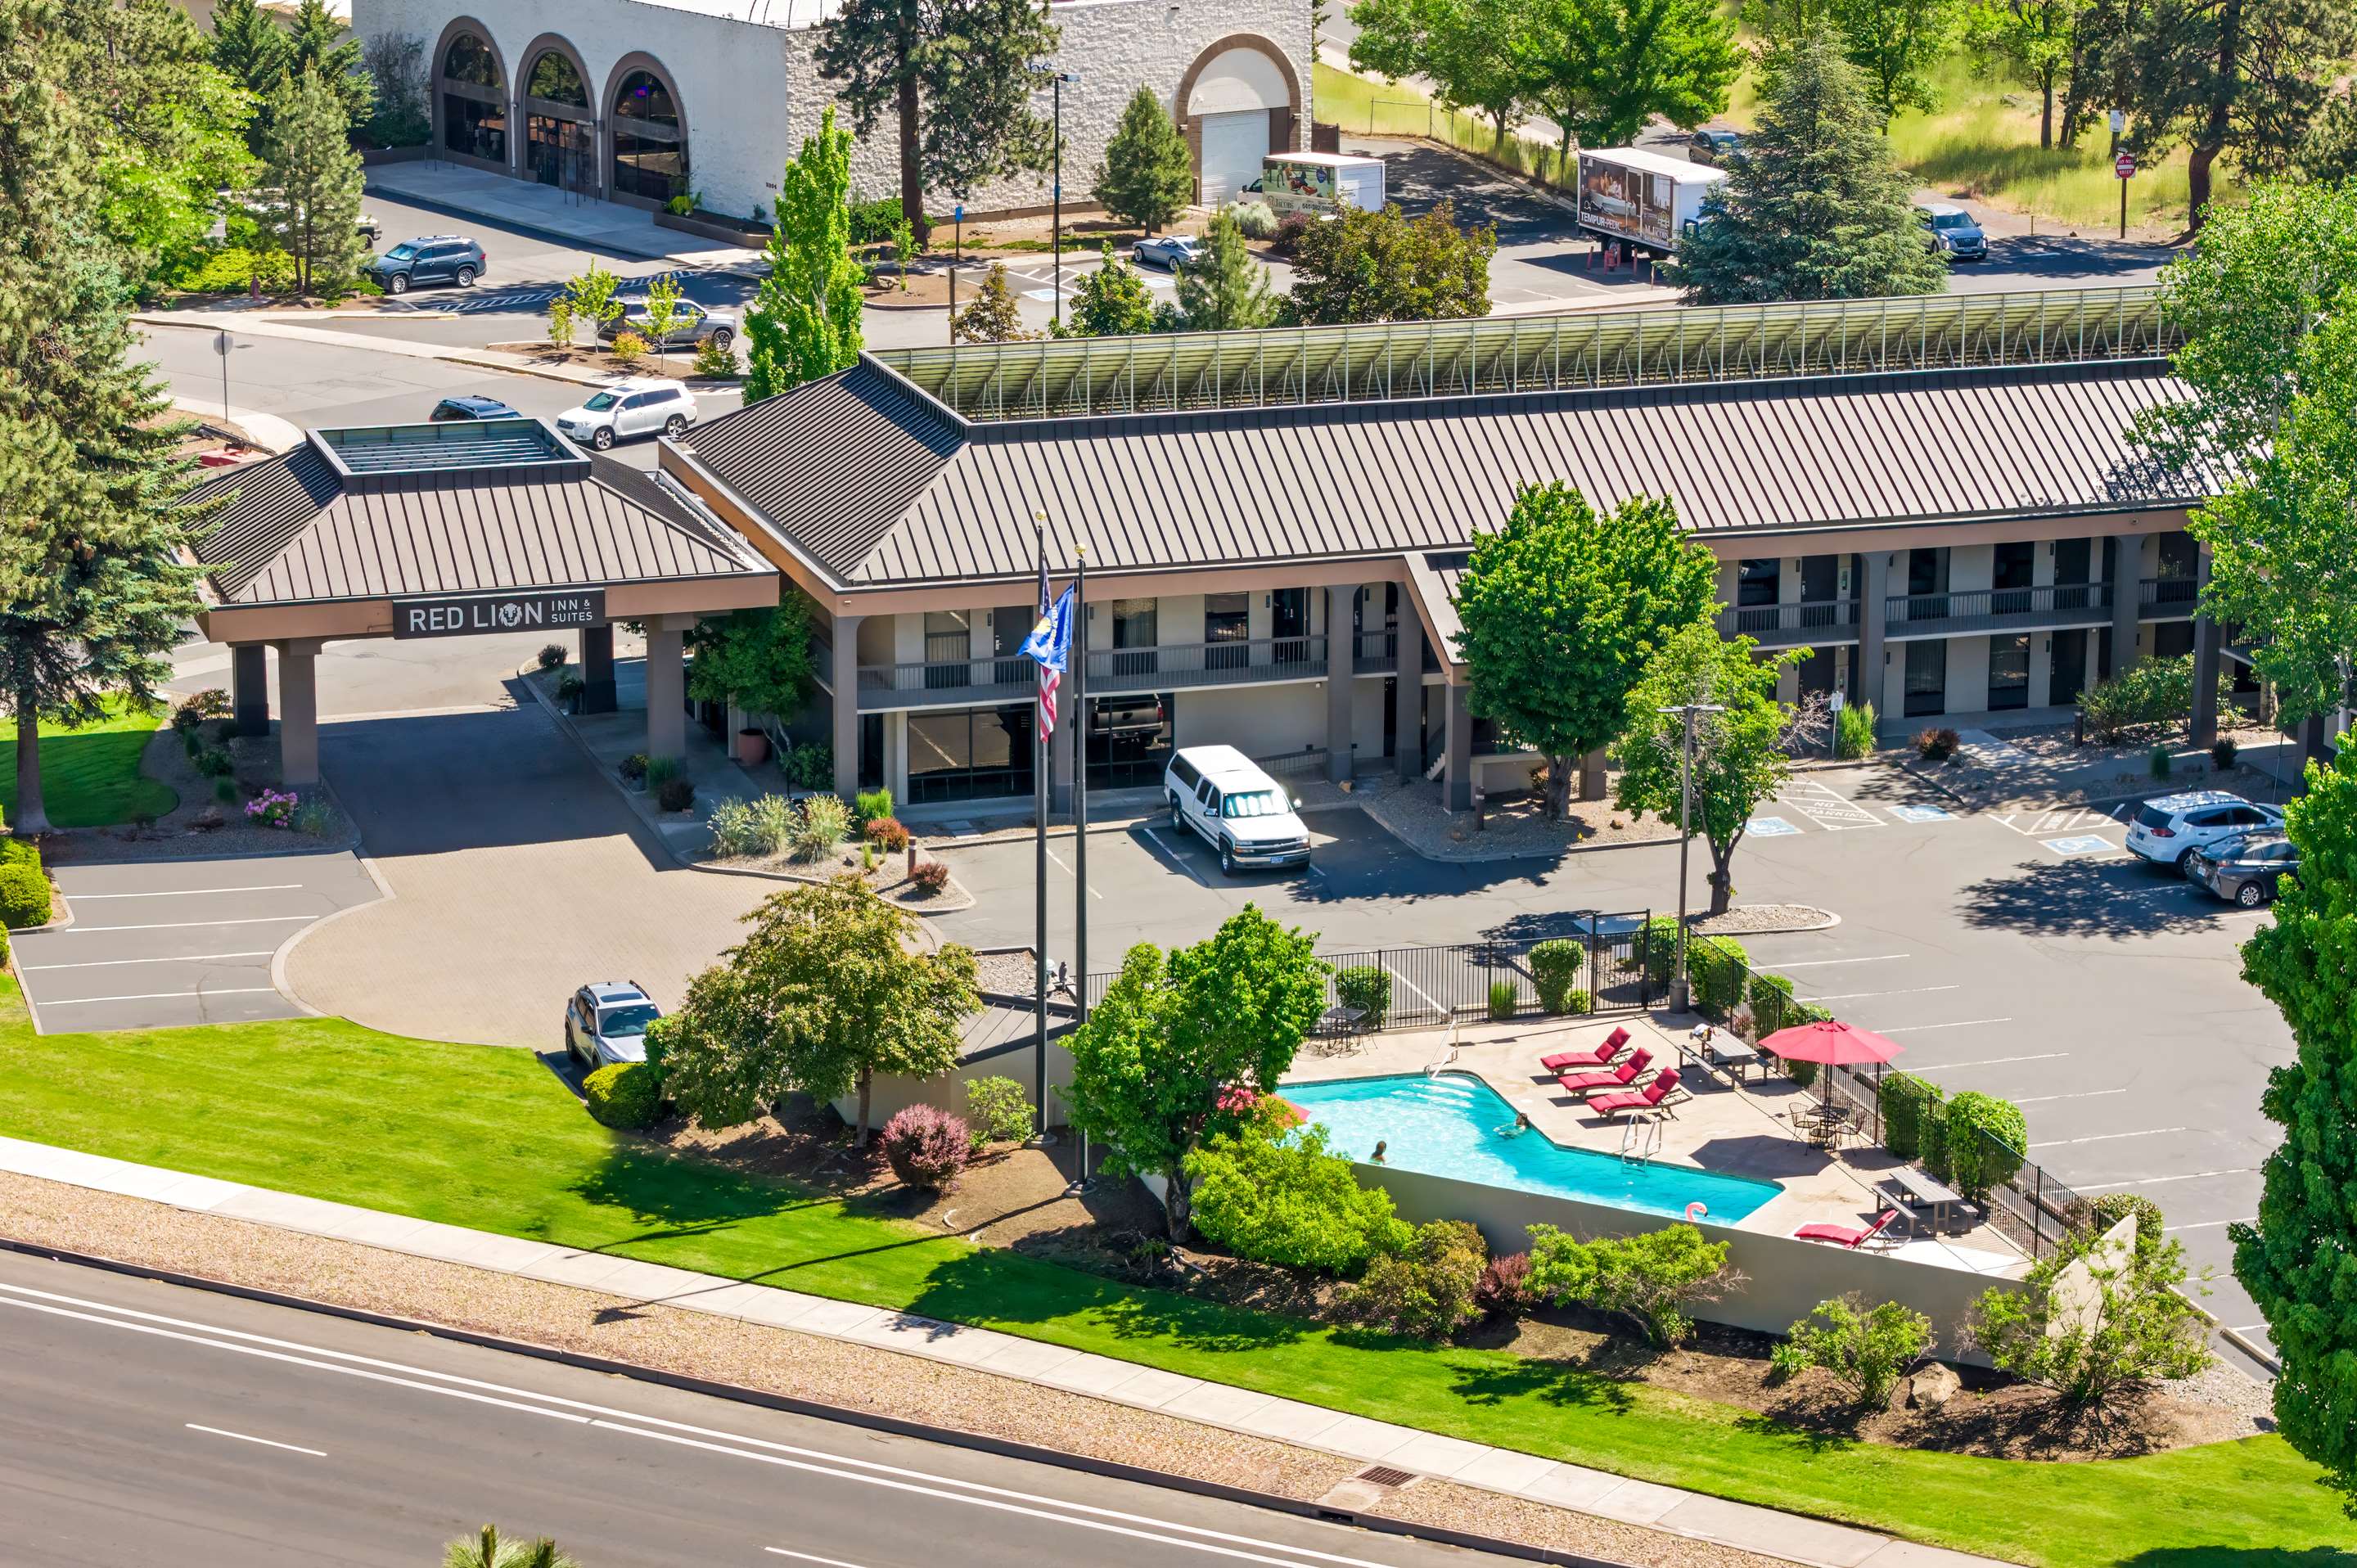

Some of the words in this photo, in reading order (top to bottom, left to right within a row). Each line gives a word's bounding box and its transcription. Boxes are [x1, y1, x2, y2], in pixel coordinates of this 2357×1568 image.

[1580, 211, 1622, 232] TEMPUR-PEDIC
[551, 599, 578, 611] INN
[584, 598, 591, 608] &
[409, 607, 464, 632] RED
[551, 611, 593, 623] SUITES
[1806, 809, 1869, 819] PARKING
